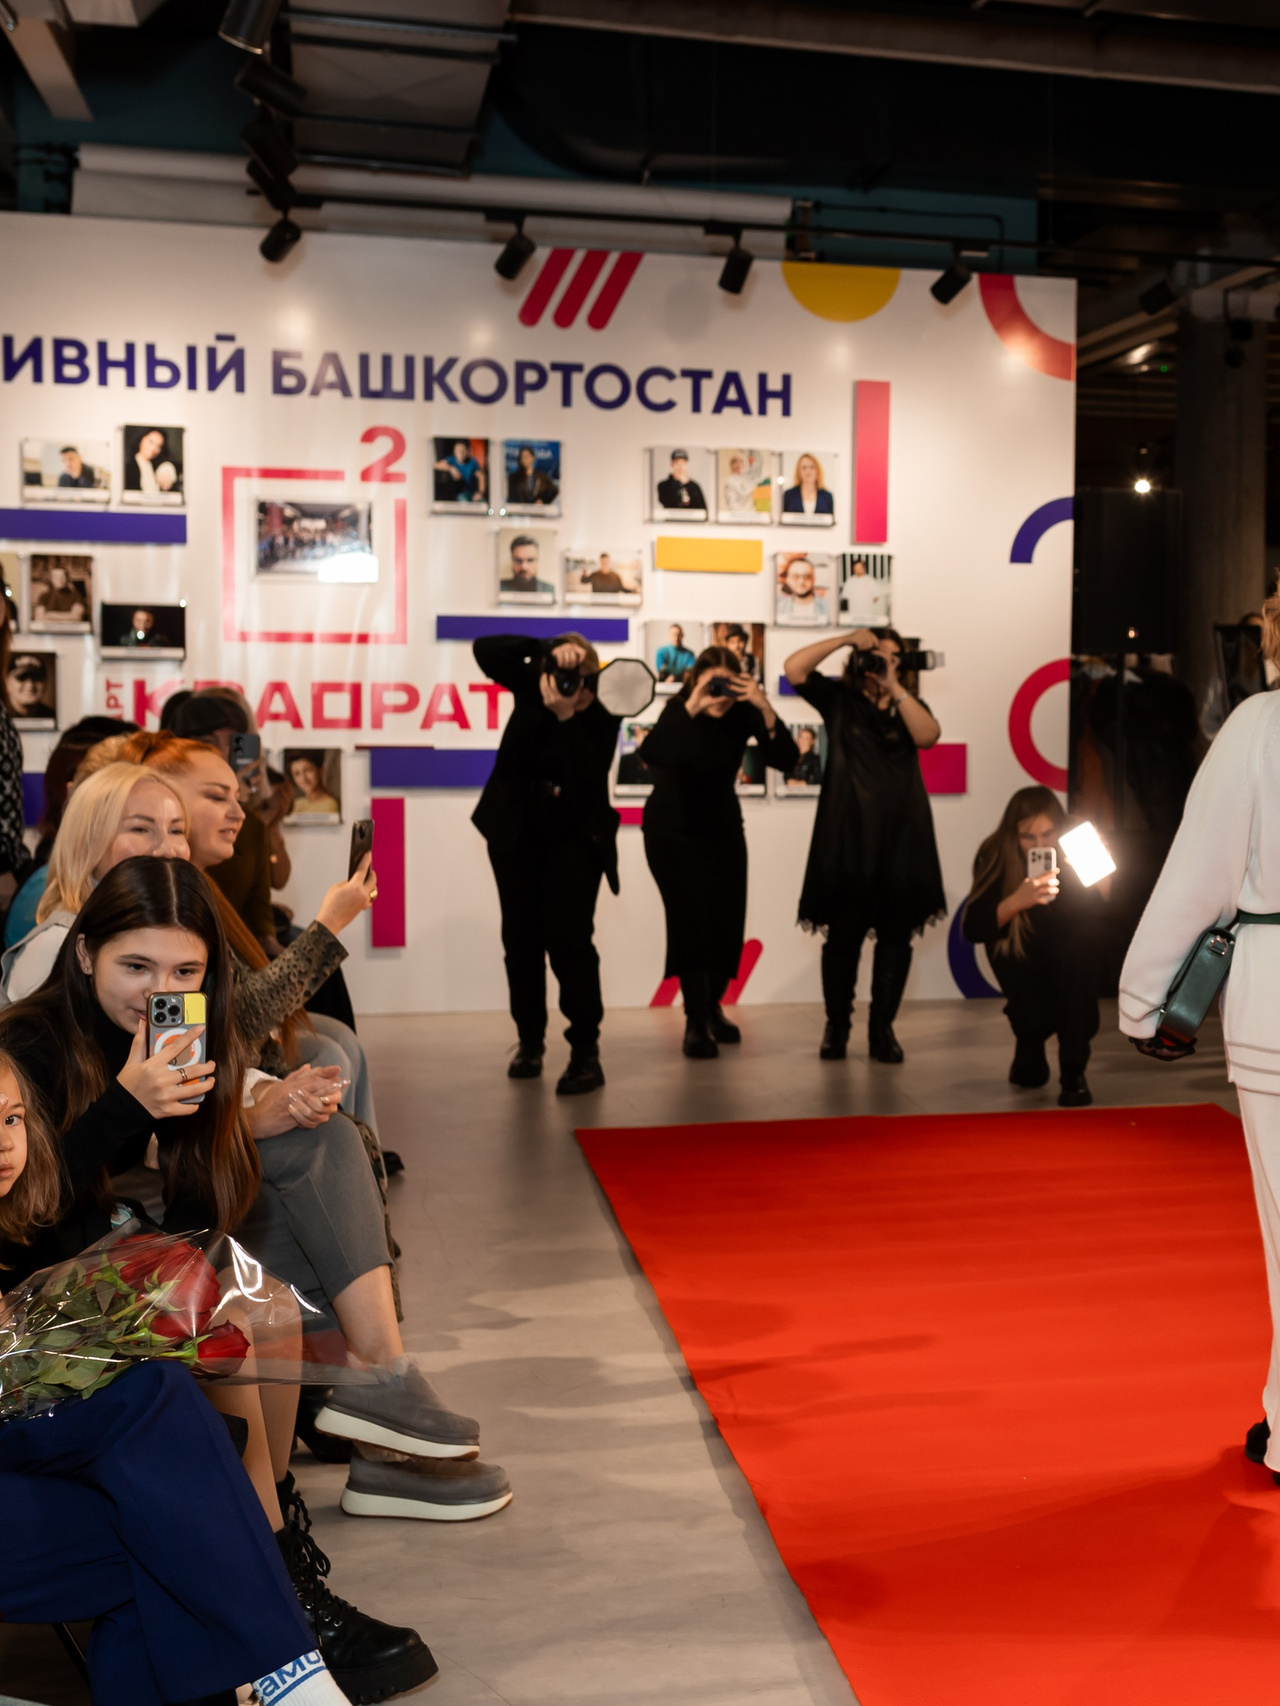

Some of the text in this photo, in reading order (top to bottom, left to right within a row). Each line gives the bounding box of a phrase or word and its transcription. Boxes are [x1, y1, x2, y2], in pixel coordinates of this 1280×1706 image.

[2, 333, 792, 418] ИВНЫЙ БАШКОРТОСТАН
[360, 426, 406, 483] 2
[105, 678, 124, 721] РТ
[133, 679, 511, 731] КАДРАТ
